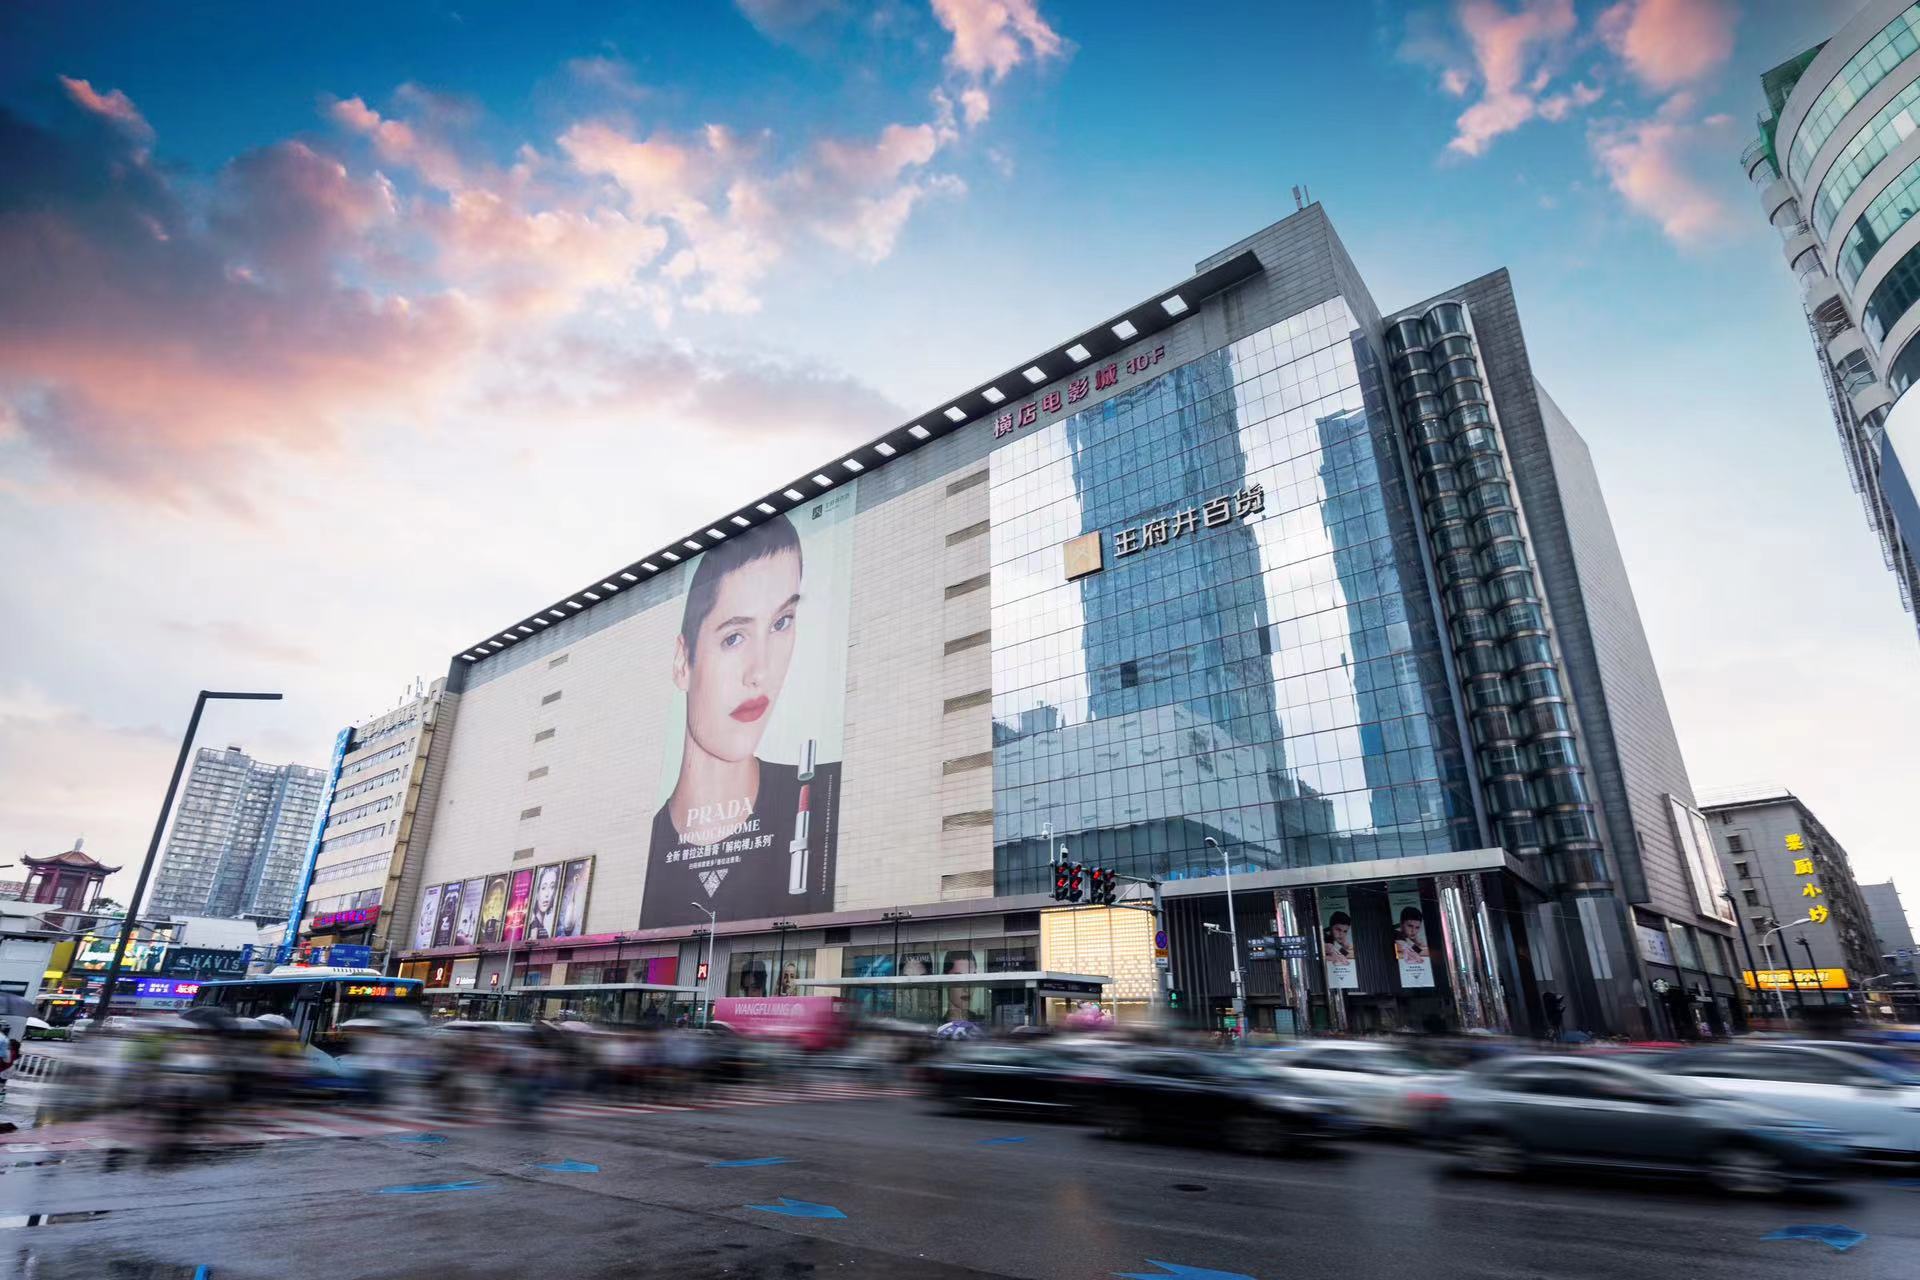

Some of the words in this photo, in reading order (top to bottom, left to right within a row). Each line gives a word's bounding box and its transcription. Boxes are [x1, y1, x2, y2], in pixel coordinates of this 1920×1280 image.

[993, 363, 1119, 438] 横店电影城
[1126, 345, 1166, 375] 10F
[1113, 484, 1265, 559] 王府井百货
[686, 797, 754, 827] PRADA
[678, 819, 761, 845] MONOCHROME
[191, 957, 240, 970] HAVIS
